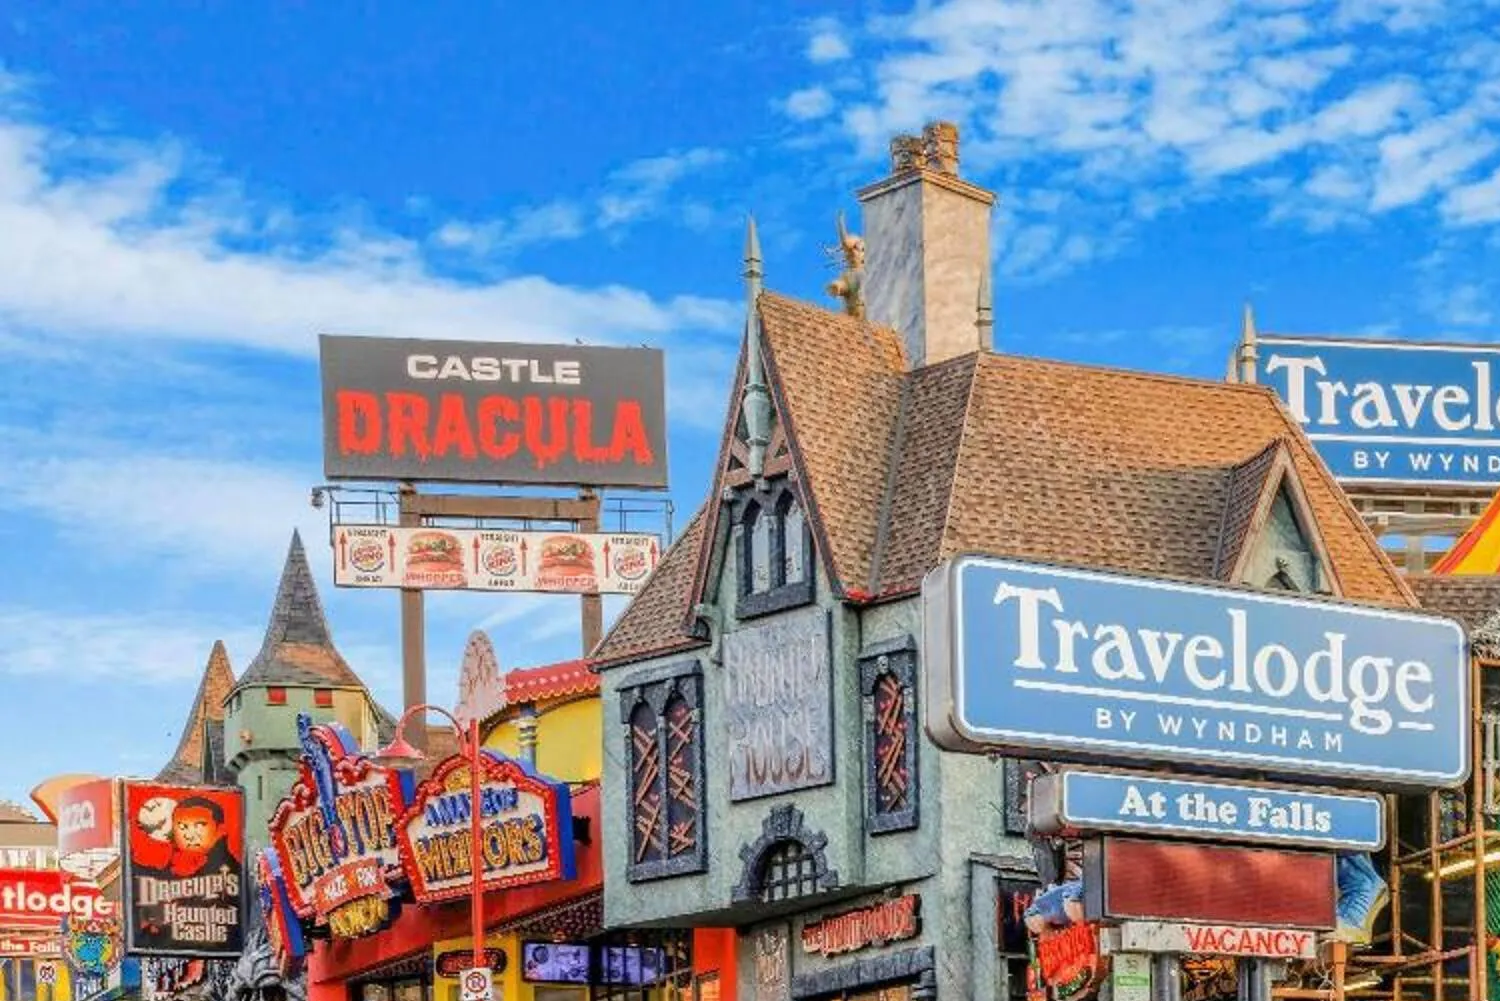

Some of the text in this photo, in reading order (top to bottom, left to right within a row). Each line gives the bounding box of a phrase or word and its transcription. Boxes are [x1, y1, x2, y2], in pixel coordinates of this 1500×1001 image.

[406, 354, 581, 385] CASTLE
[335, 387, 656, 470] DRACULA
[1353, 450, 1391, 470] BY
[992, 581, 1434, 736] Travelodge
[1095, 709, 1344, 753] BY WYNDHAM
[1118, 785, 1332, 834] At the Falls
[281, 785, 395, 889] BIG TOP
[162, 901, 239, 926] Haunted
[172, 920, 229, 943] Castle
[1184, 926, 1310, 957] VACANCY
